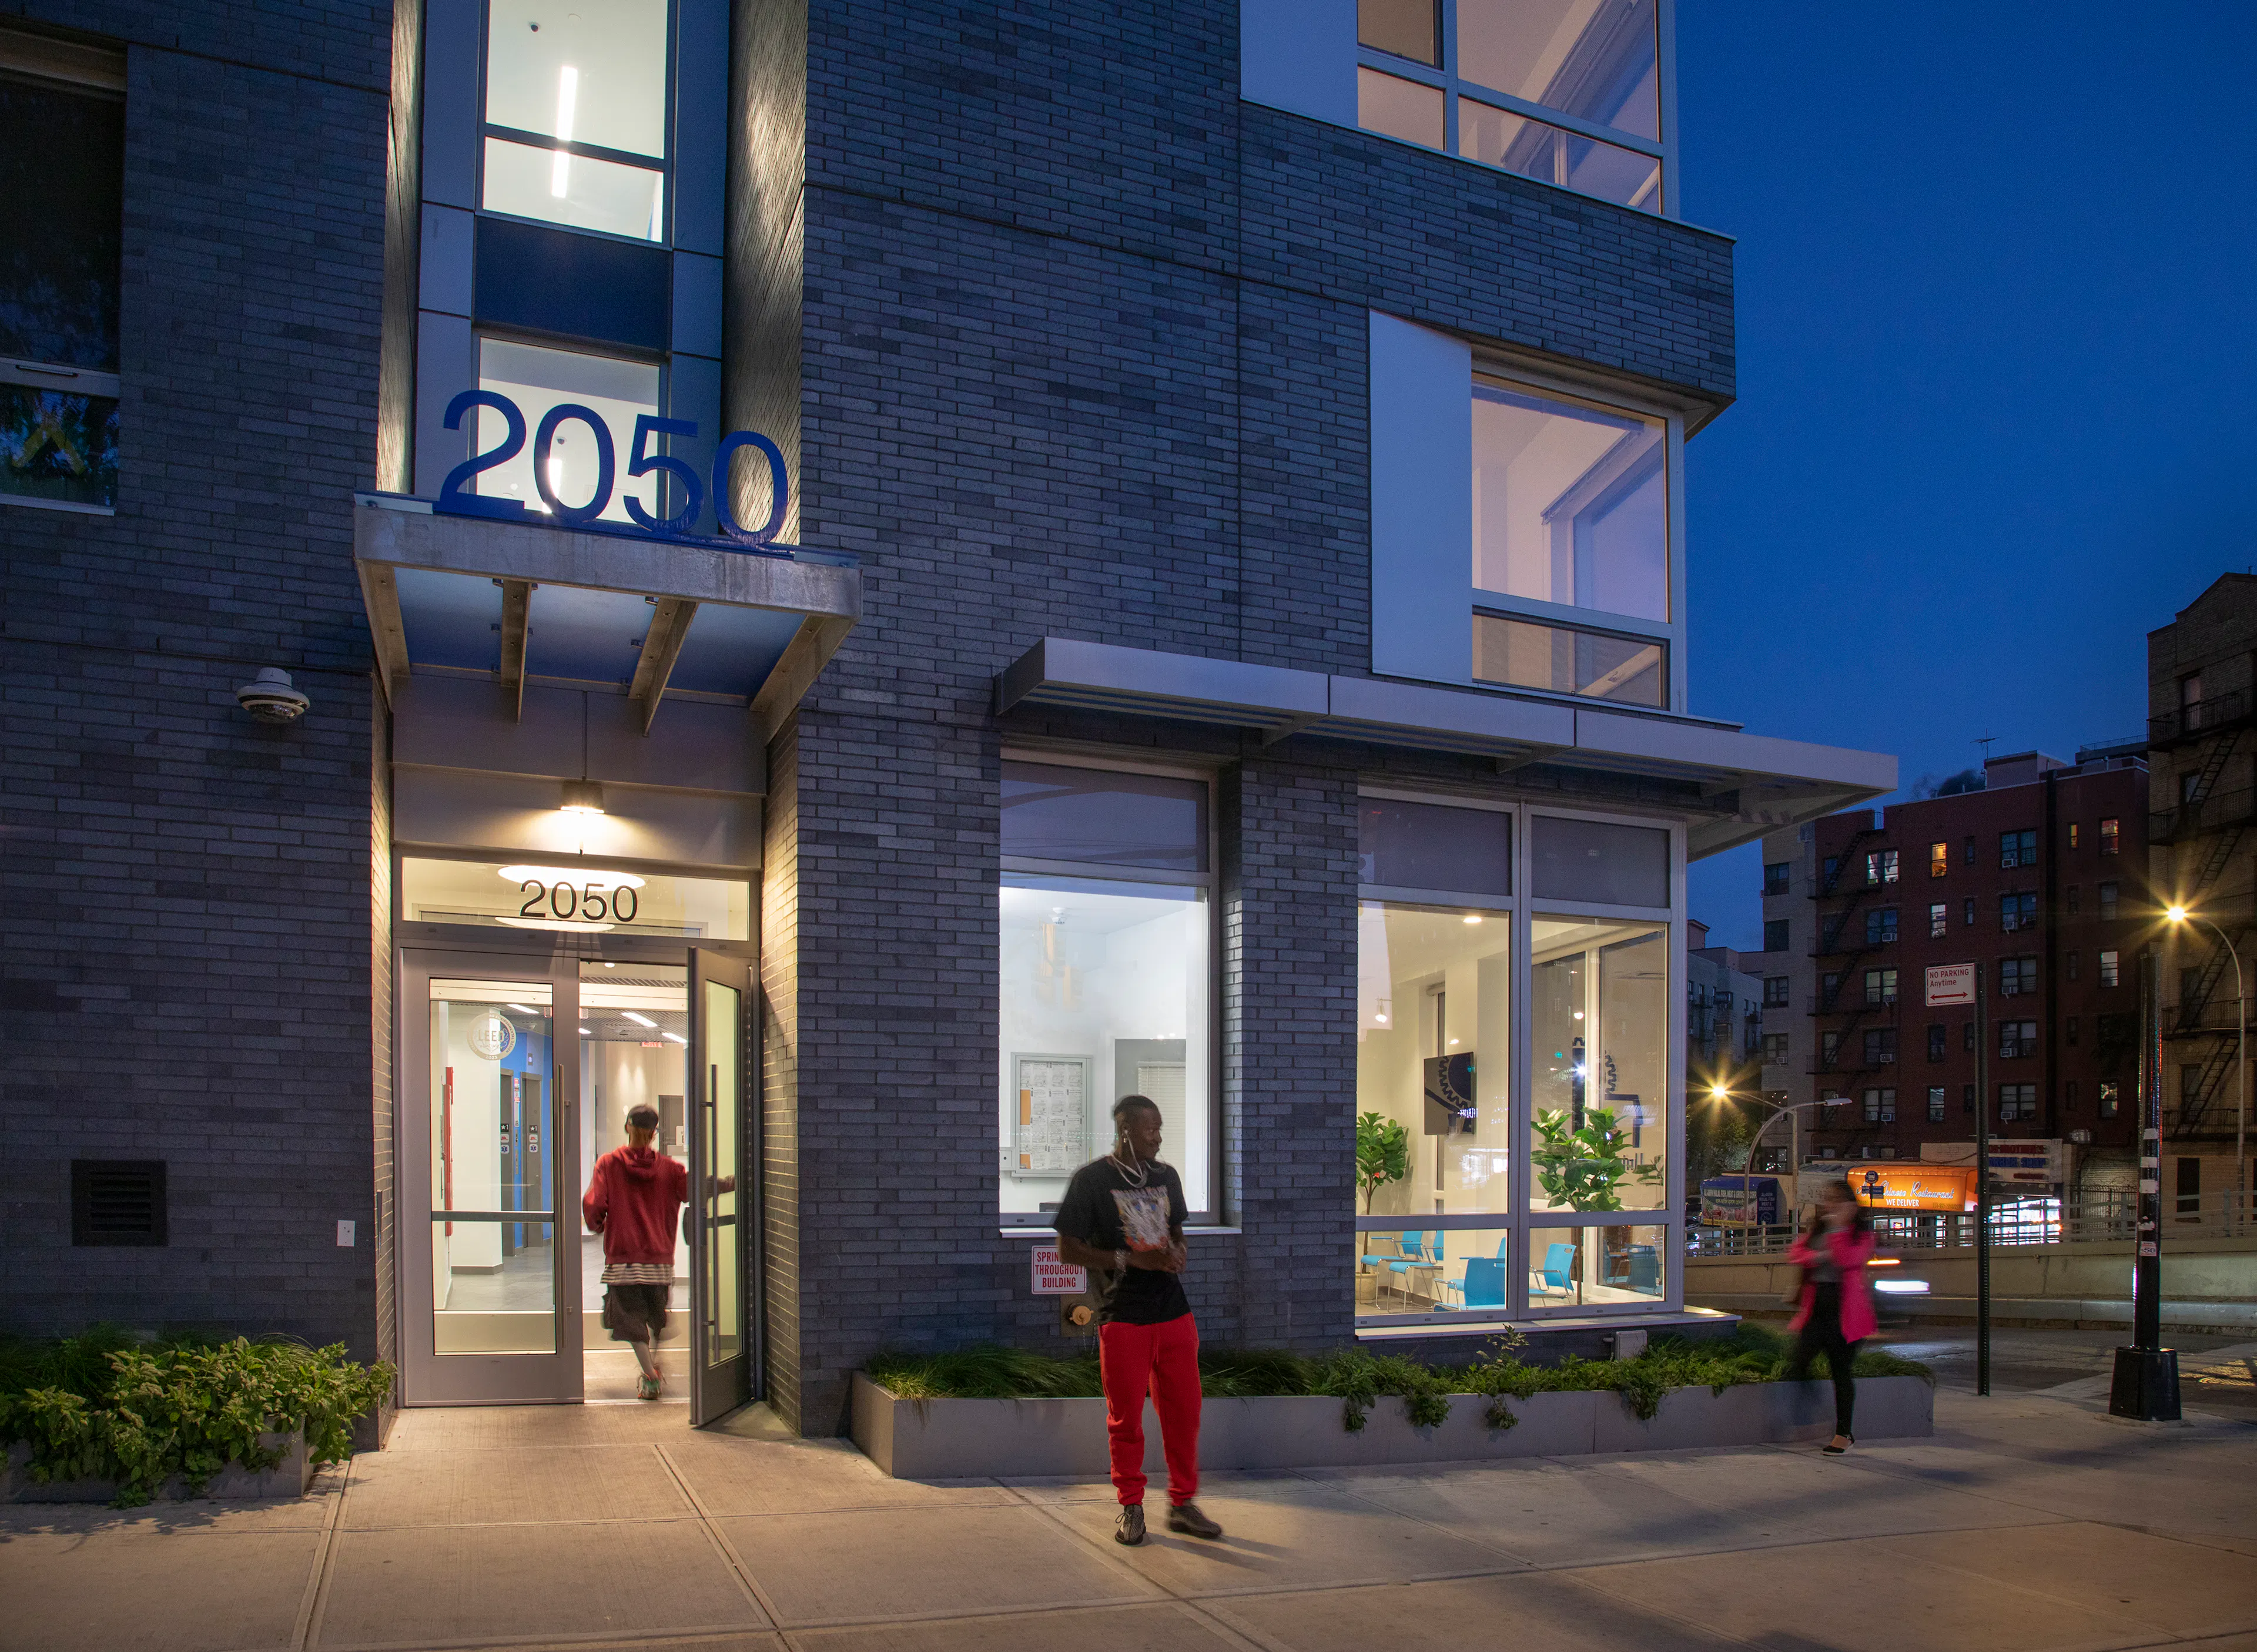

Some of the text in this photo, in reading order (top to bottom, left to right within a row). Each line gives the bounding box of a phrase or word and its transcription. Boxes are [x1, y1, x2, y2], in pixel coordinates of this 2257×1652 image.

[440, 389, 789, 548] 2050
[520, 880, 638, 923] 2050
[1941, 969, 1969, 978] PARKING
[1930, 979, 1957, 988] Anytime
[478, 1029, 505, 1042] LEED
[1910, 1181, 1954, 1199] Restaurant
[1886, 1198, 1919, 1207] WE DELIVER
[1037, 1252, 1060, 1262] SPRIN
[1042, 1277, 1076, 1288] BUILDING
